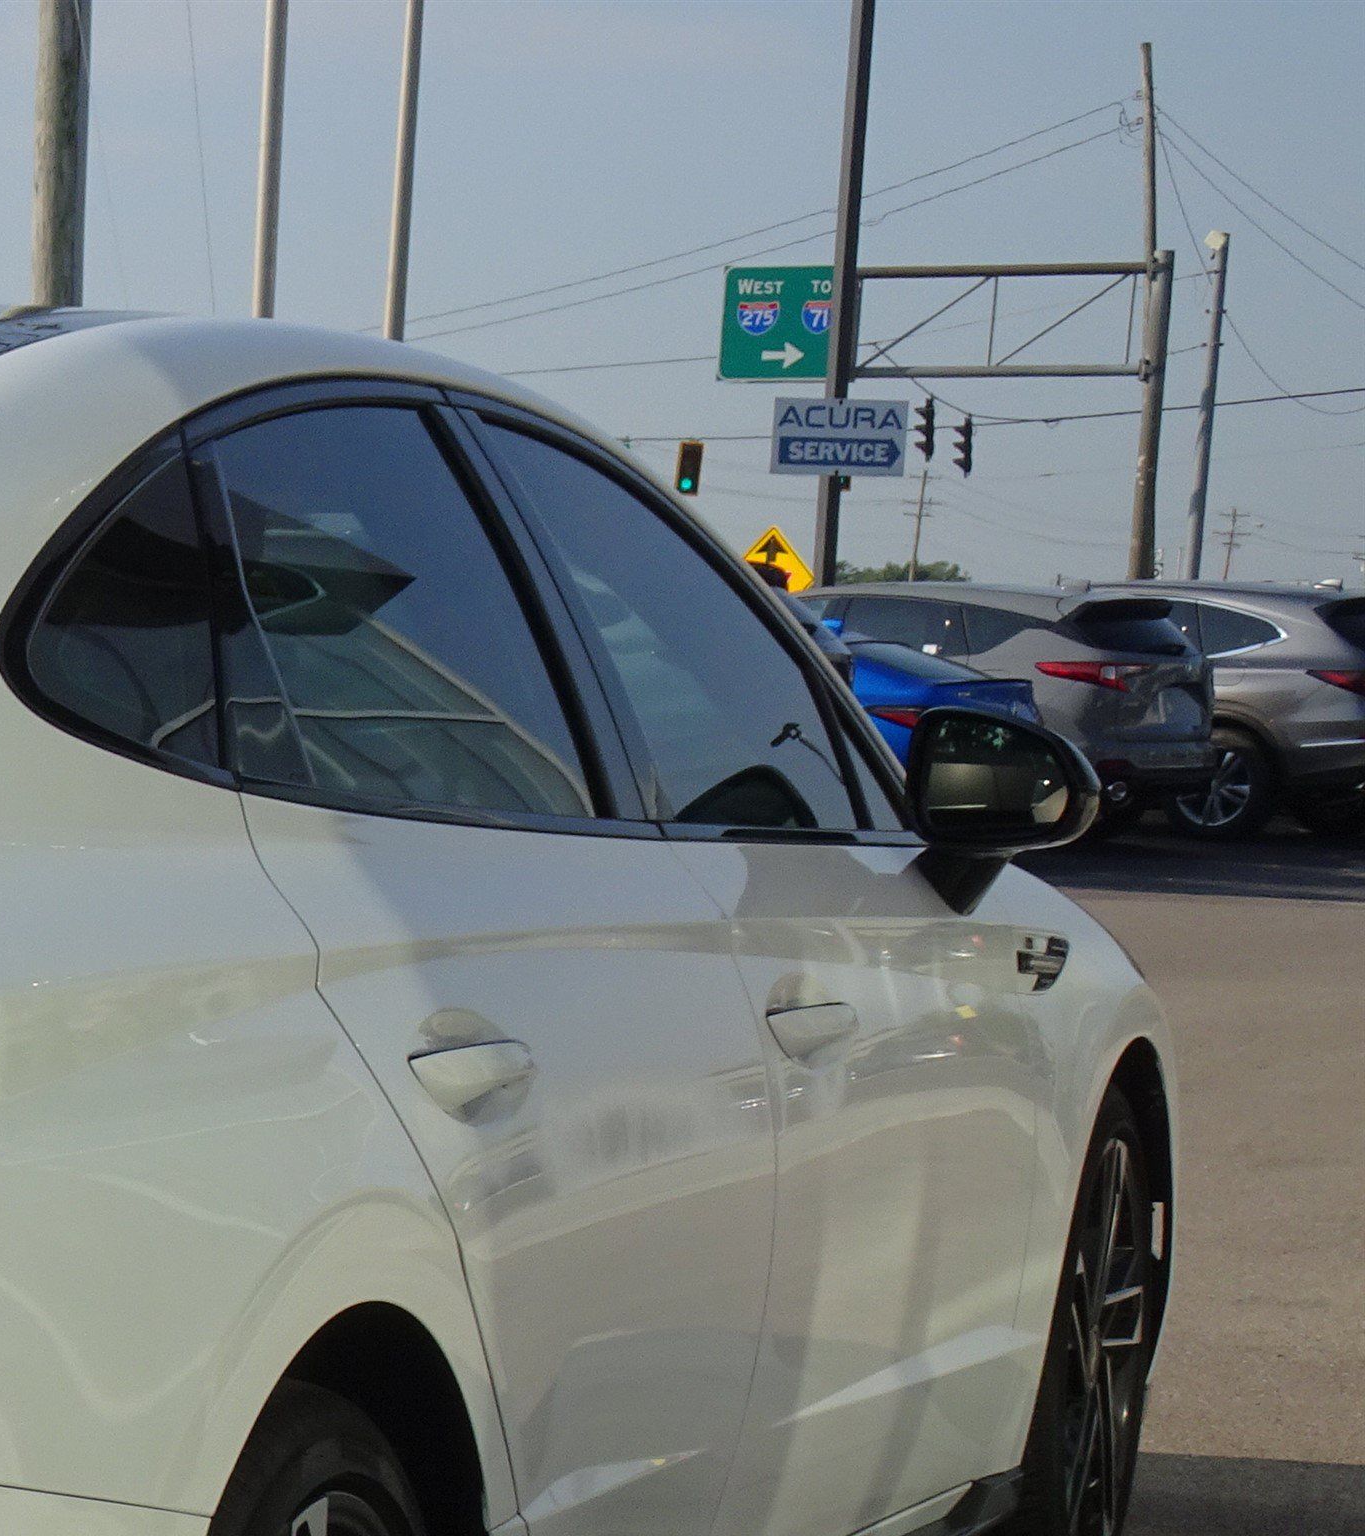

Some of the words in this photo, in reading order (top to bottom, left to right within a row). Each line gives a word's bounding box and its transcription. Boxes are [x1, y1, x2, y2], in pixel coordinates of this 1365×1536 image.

[737, 279, 784, 295] WEST
[811, 279, 832, 293] TO
[742, 310, 774, 326] 275
[810, 309, 828, 328] 71
[779, 405, 902, 429] ACURA
[787, 441, 889, 463] SERVICE
